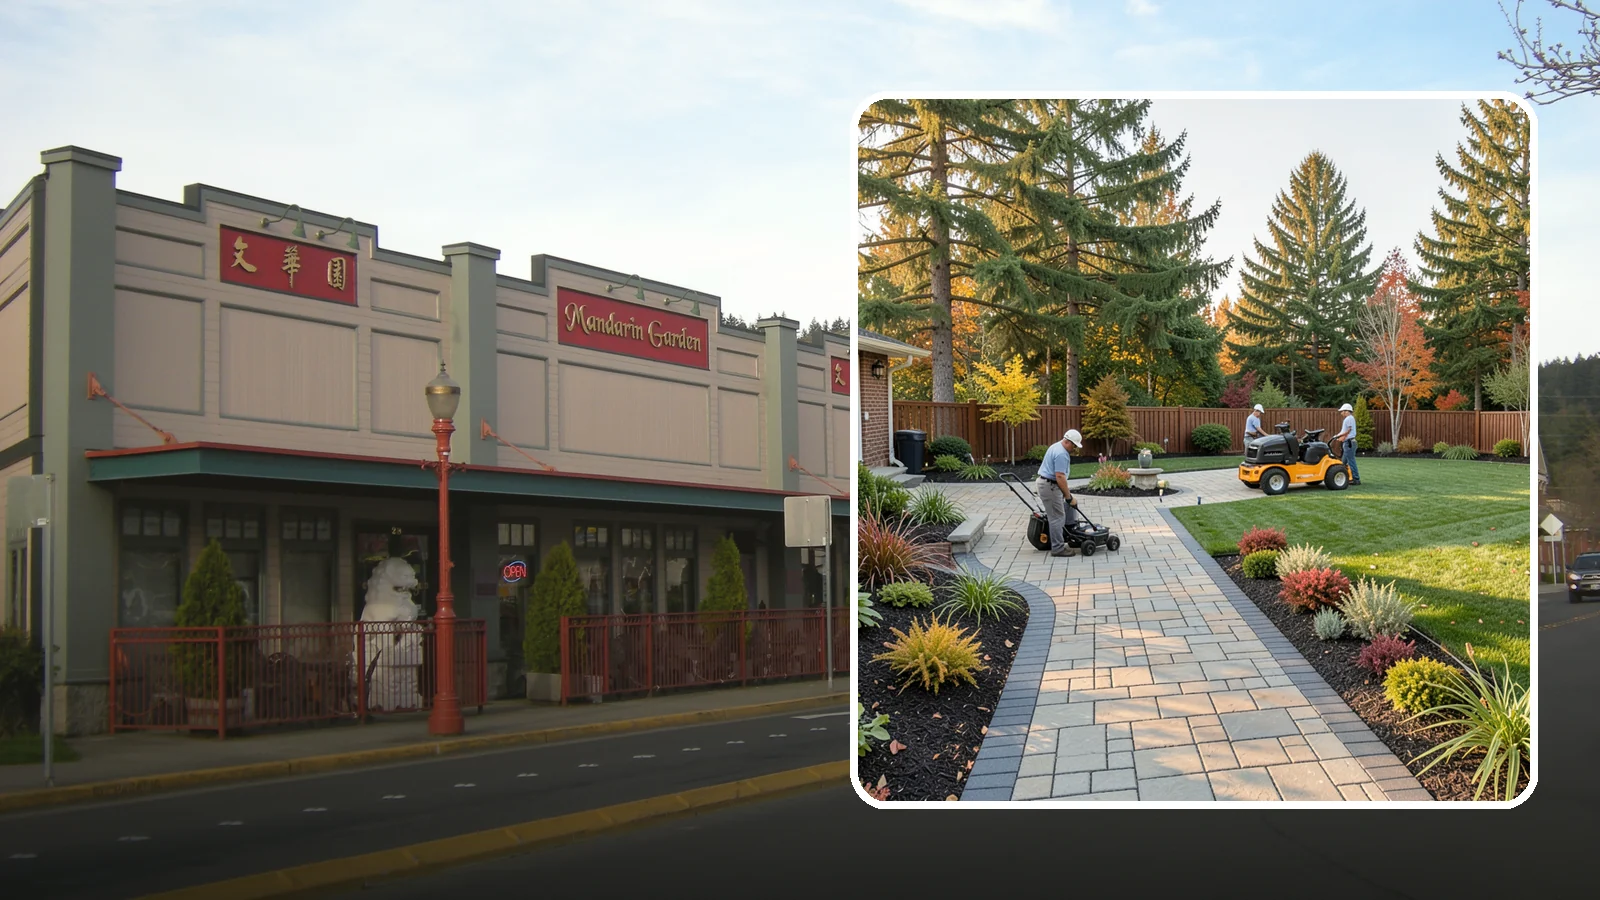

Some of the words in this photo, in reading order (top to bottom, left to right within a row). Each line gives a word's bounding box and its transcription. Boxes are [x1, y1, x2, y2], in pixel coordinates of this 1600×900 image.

[231, 236, 346, 291] 文華園
[564, 302, 643, 340] Mandarin
[648, 320, 701, 352] Garden
[503, 565, 527, 578] OPEN
